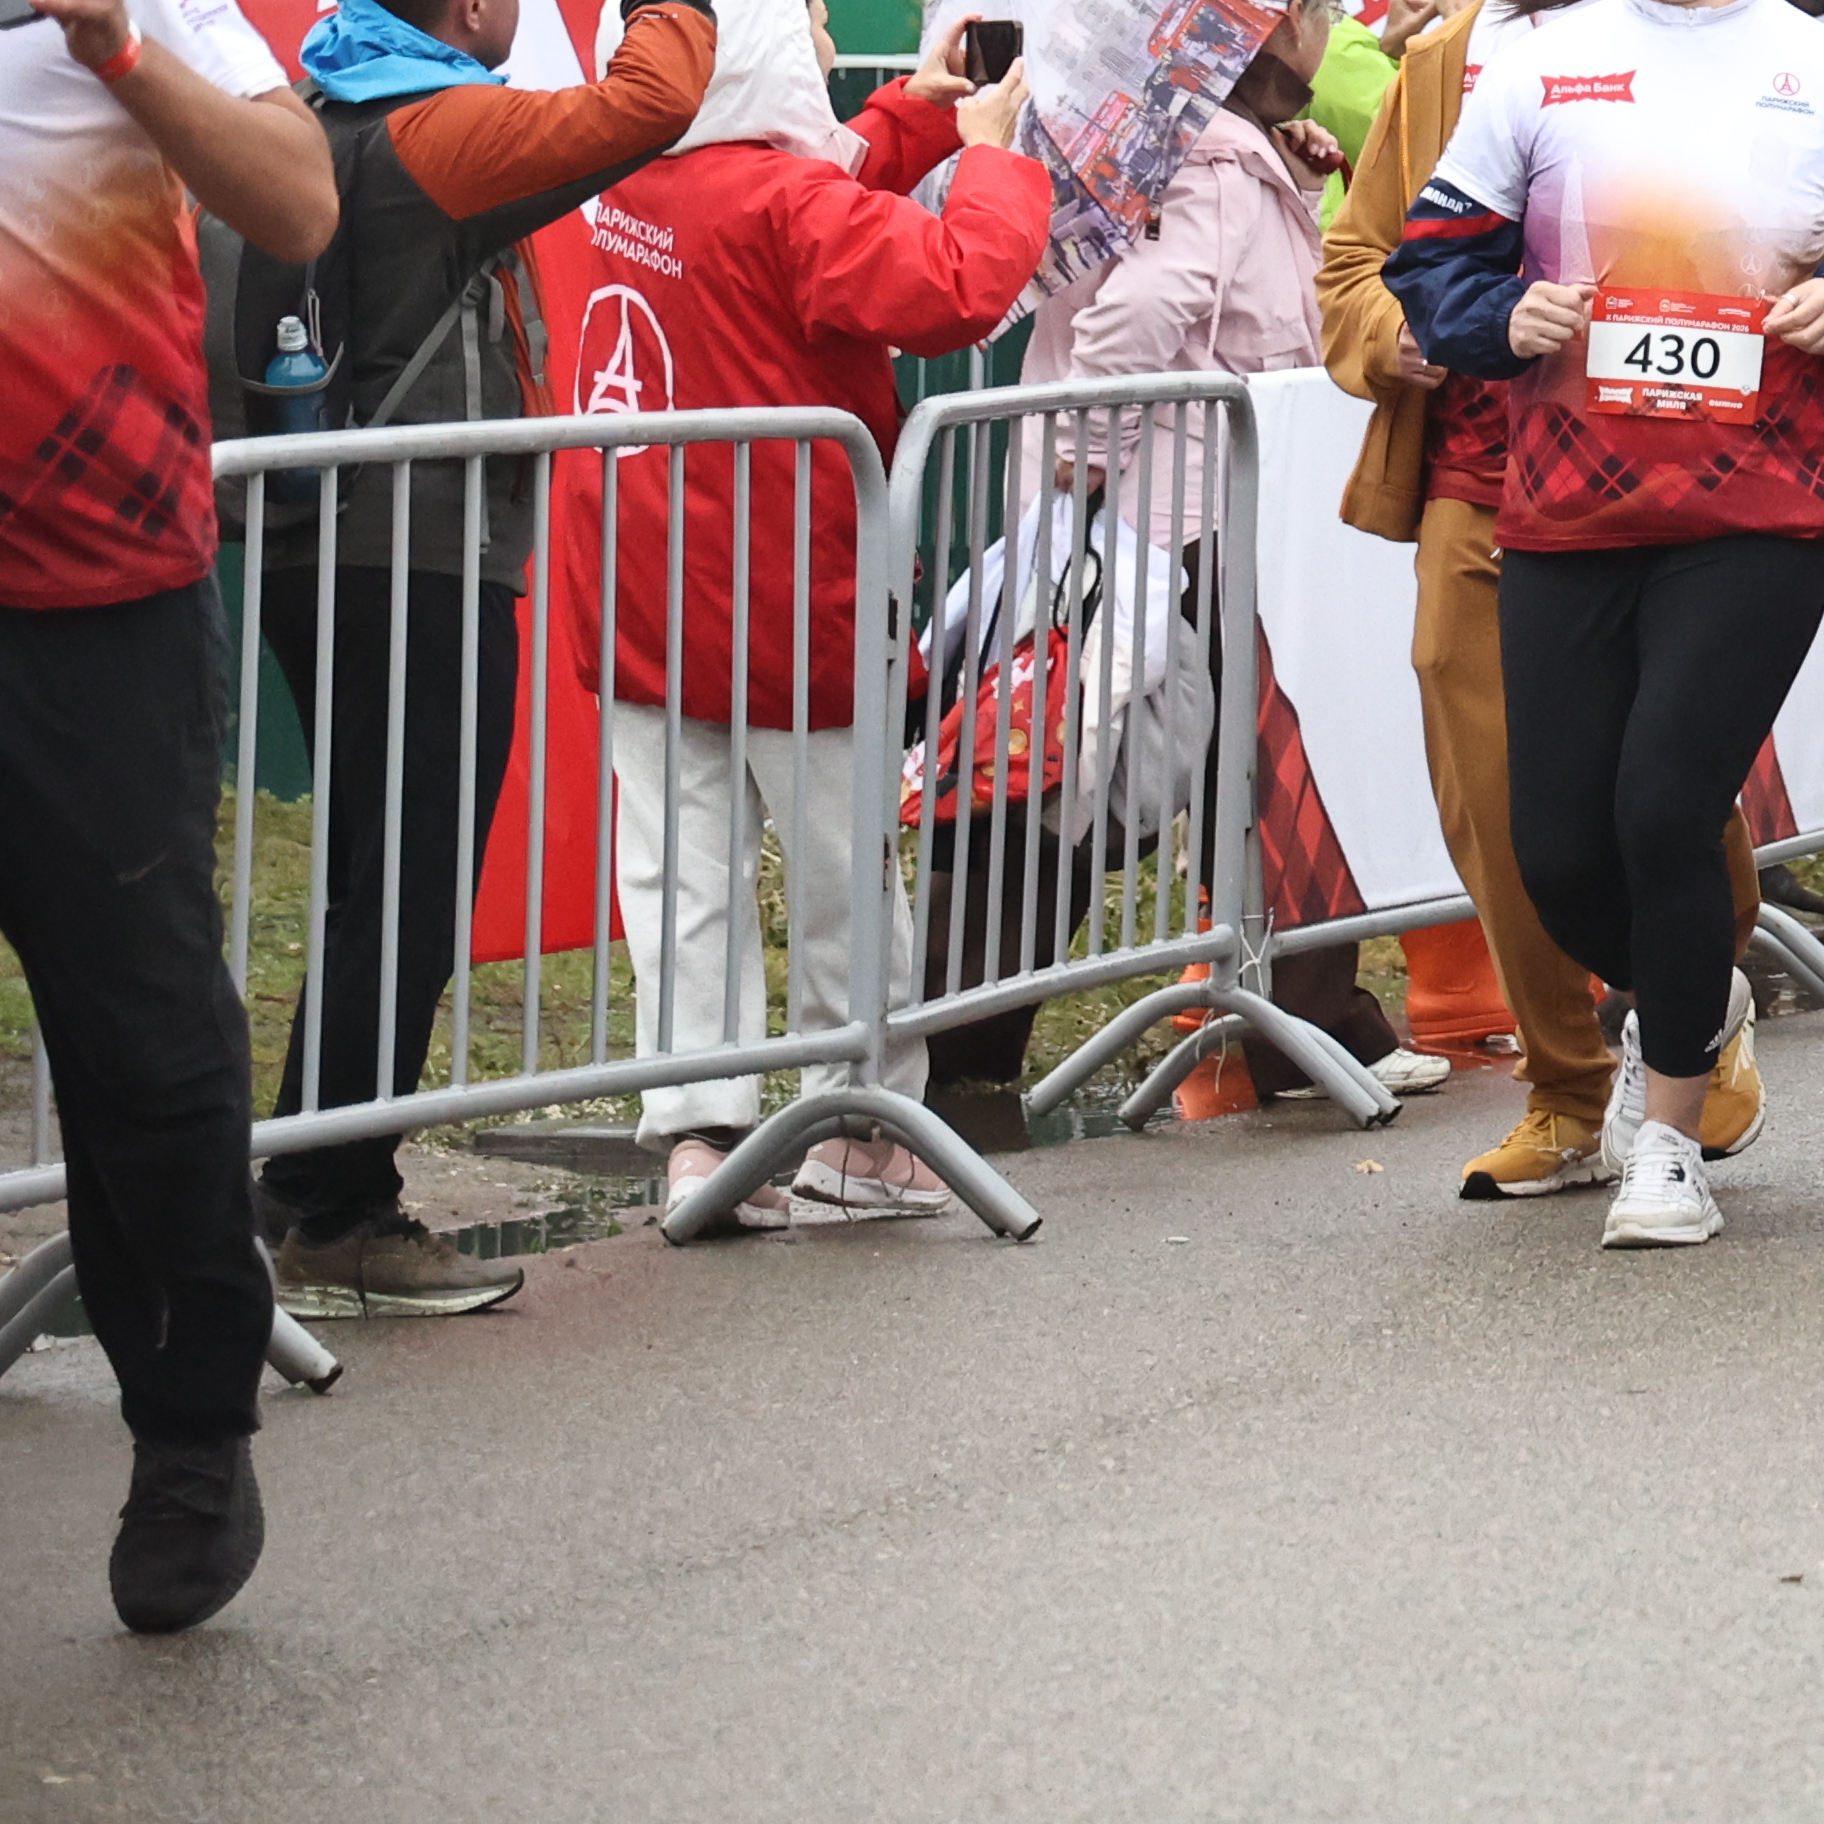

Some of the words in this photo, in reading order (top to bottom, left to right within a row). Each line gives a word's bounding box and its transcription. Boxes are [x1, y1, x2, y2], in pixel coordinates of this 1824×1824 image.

[1551, 83, 1591, 95] Альфа
[1593, 82, 1625, 93] Банк
[590, 225, 683, 280] ЛУМАРАФОН
[1624, 332, 1721, 379] 430
[1641, 387, 1703, 401] ПАРИЖСКАЯ
[1656, 399, 1687, 410] МИЛЯ
